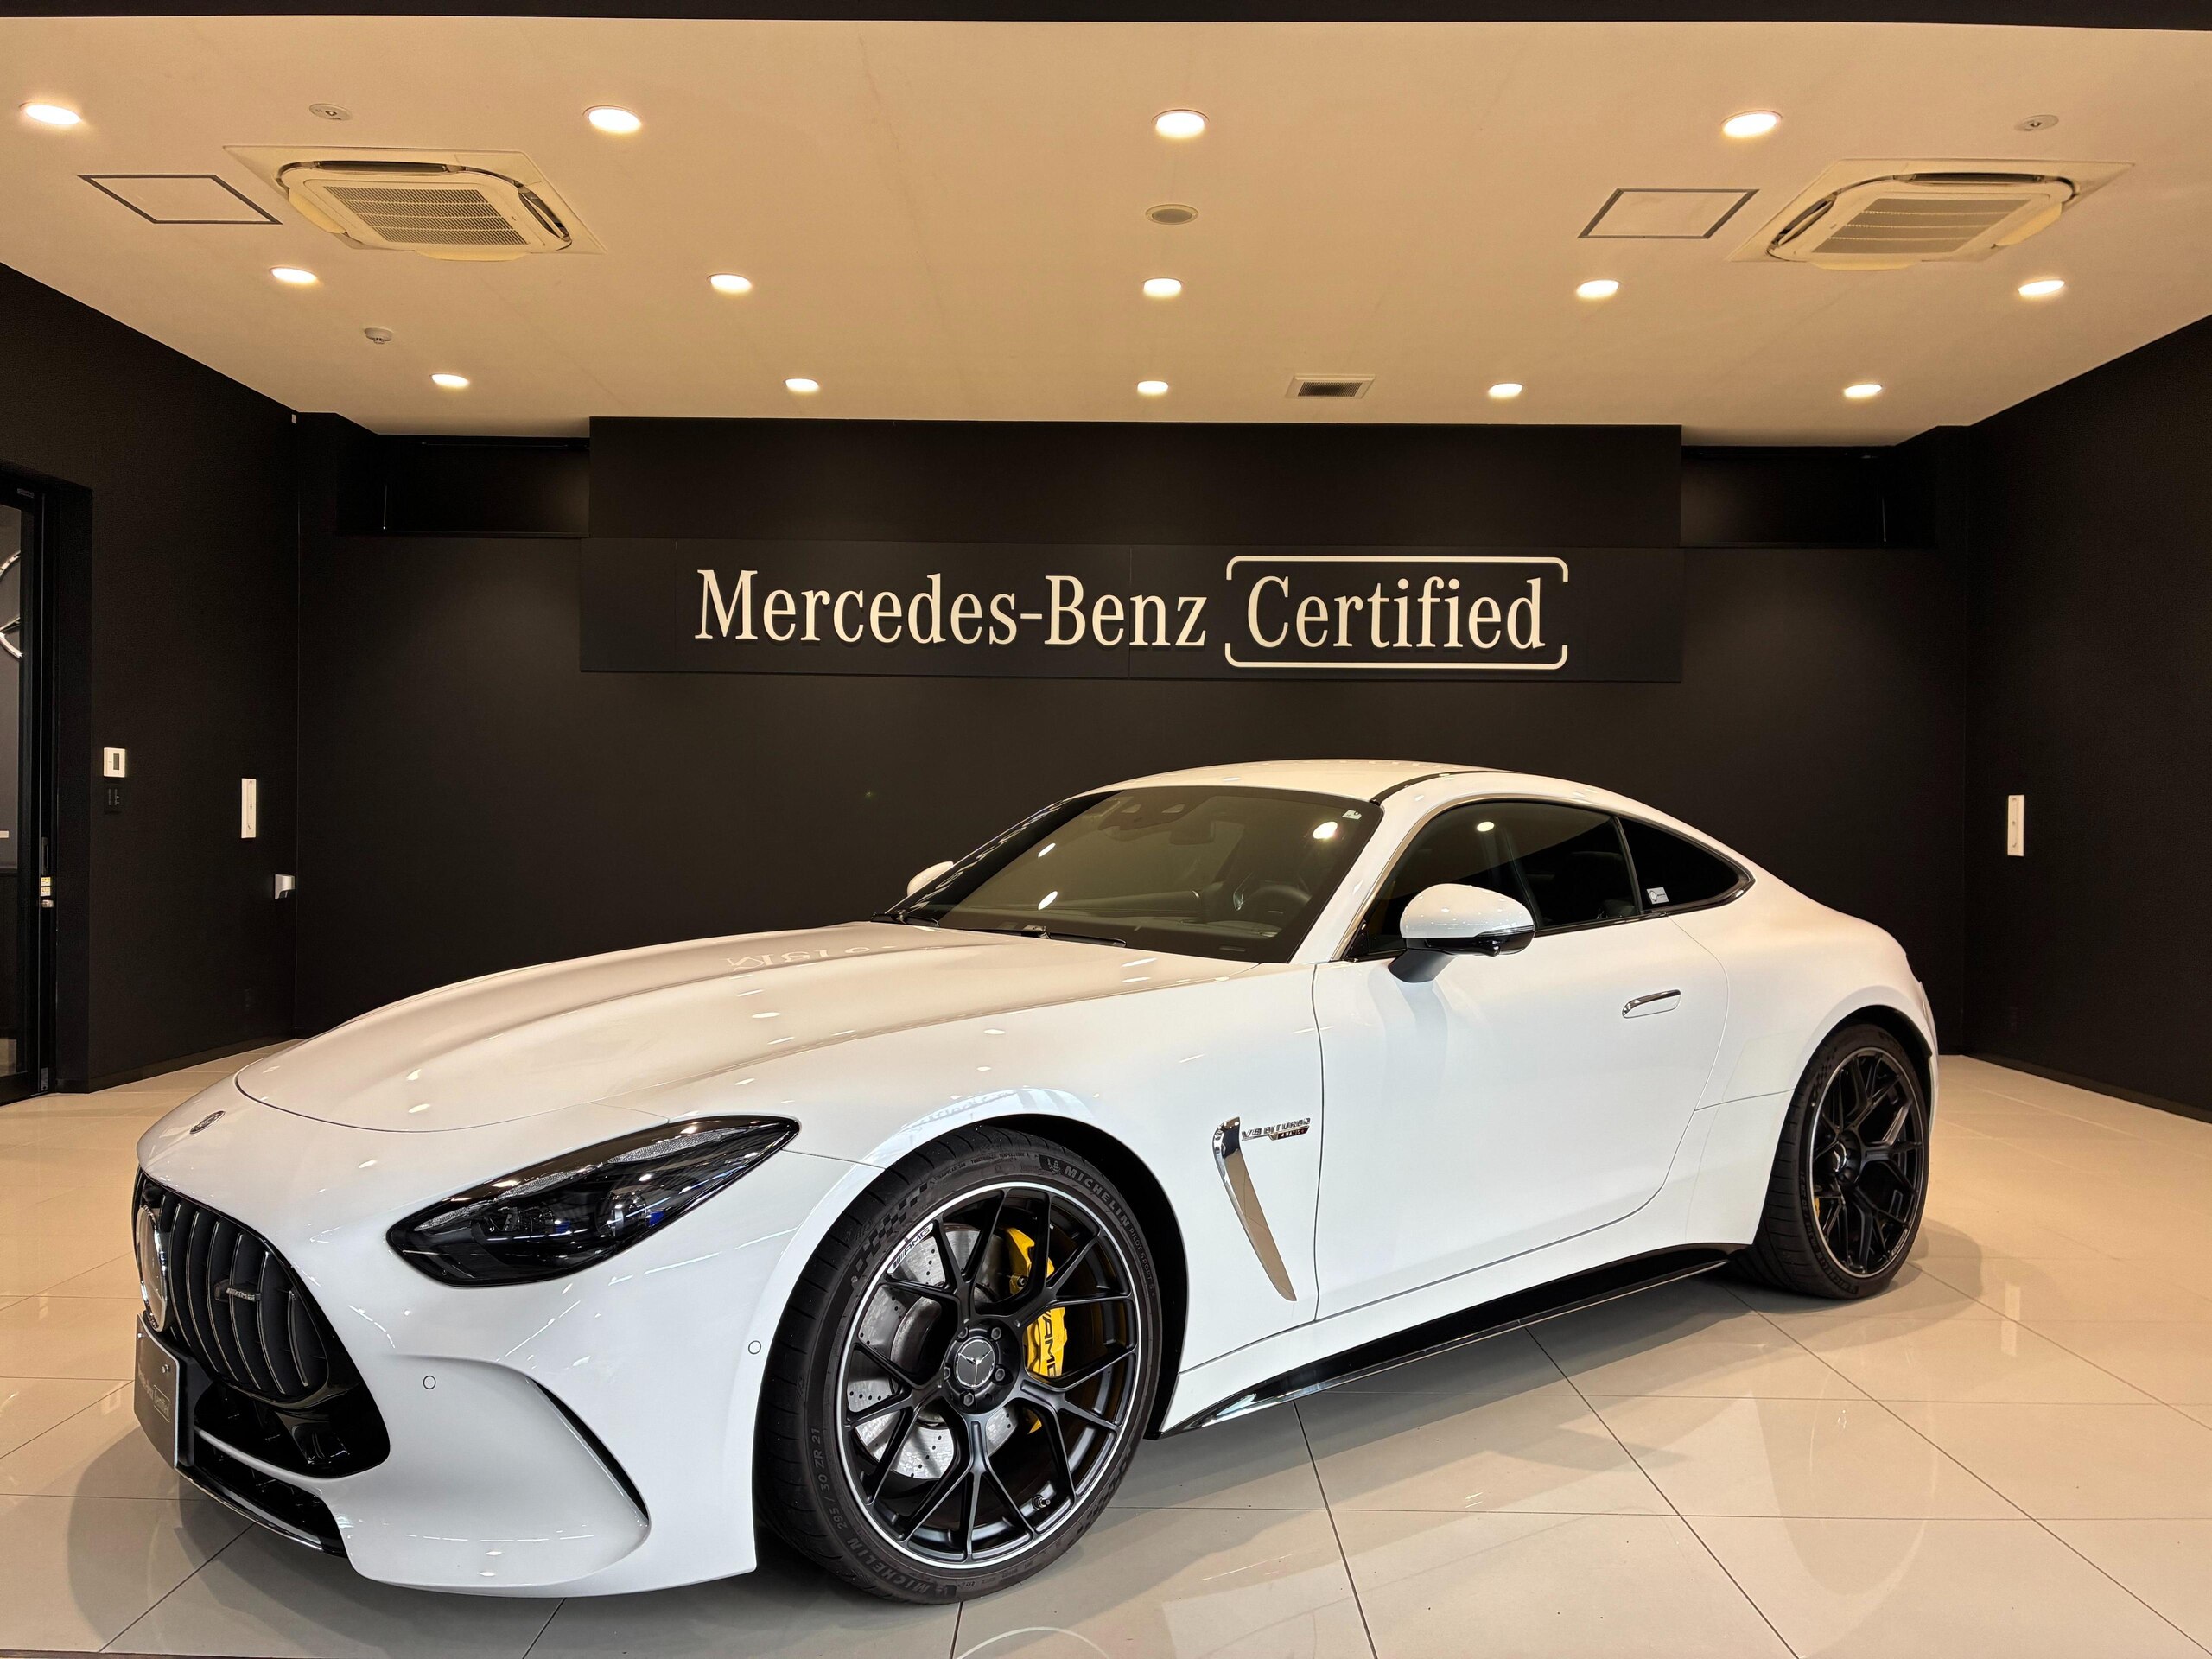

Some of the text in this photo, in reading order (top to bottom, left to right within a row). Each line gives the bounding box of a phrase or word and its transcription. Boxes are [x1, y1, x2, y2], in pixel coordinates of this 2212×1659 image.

[694, 570, 1546, 649] Mercedes-Benz Certified
[1064, 1166, 1130, 1228] MICHELIN
[1128, 1228, 1142, 1250] PILOT
[810, 1427, 821, 1445] 21
[812, 1449, 825, 1469] ZR
[817, 1474, 830, 1493] 30
[830, 1507, 848, 1529] 295
[847, 1538, 931, 1594] MICHELIN
